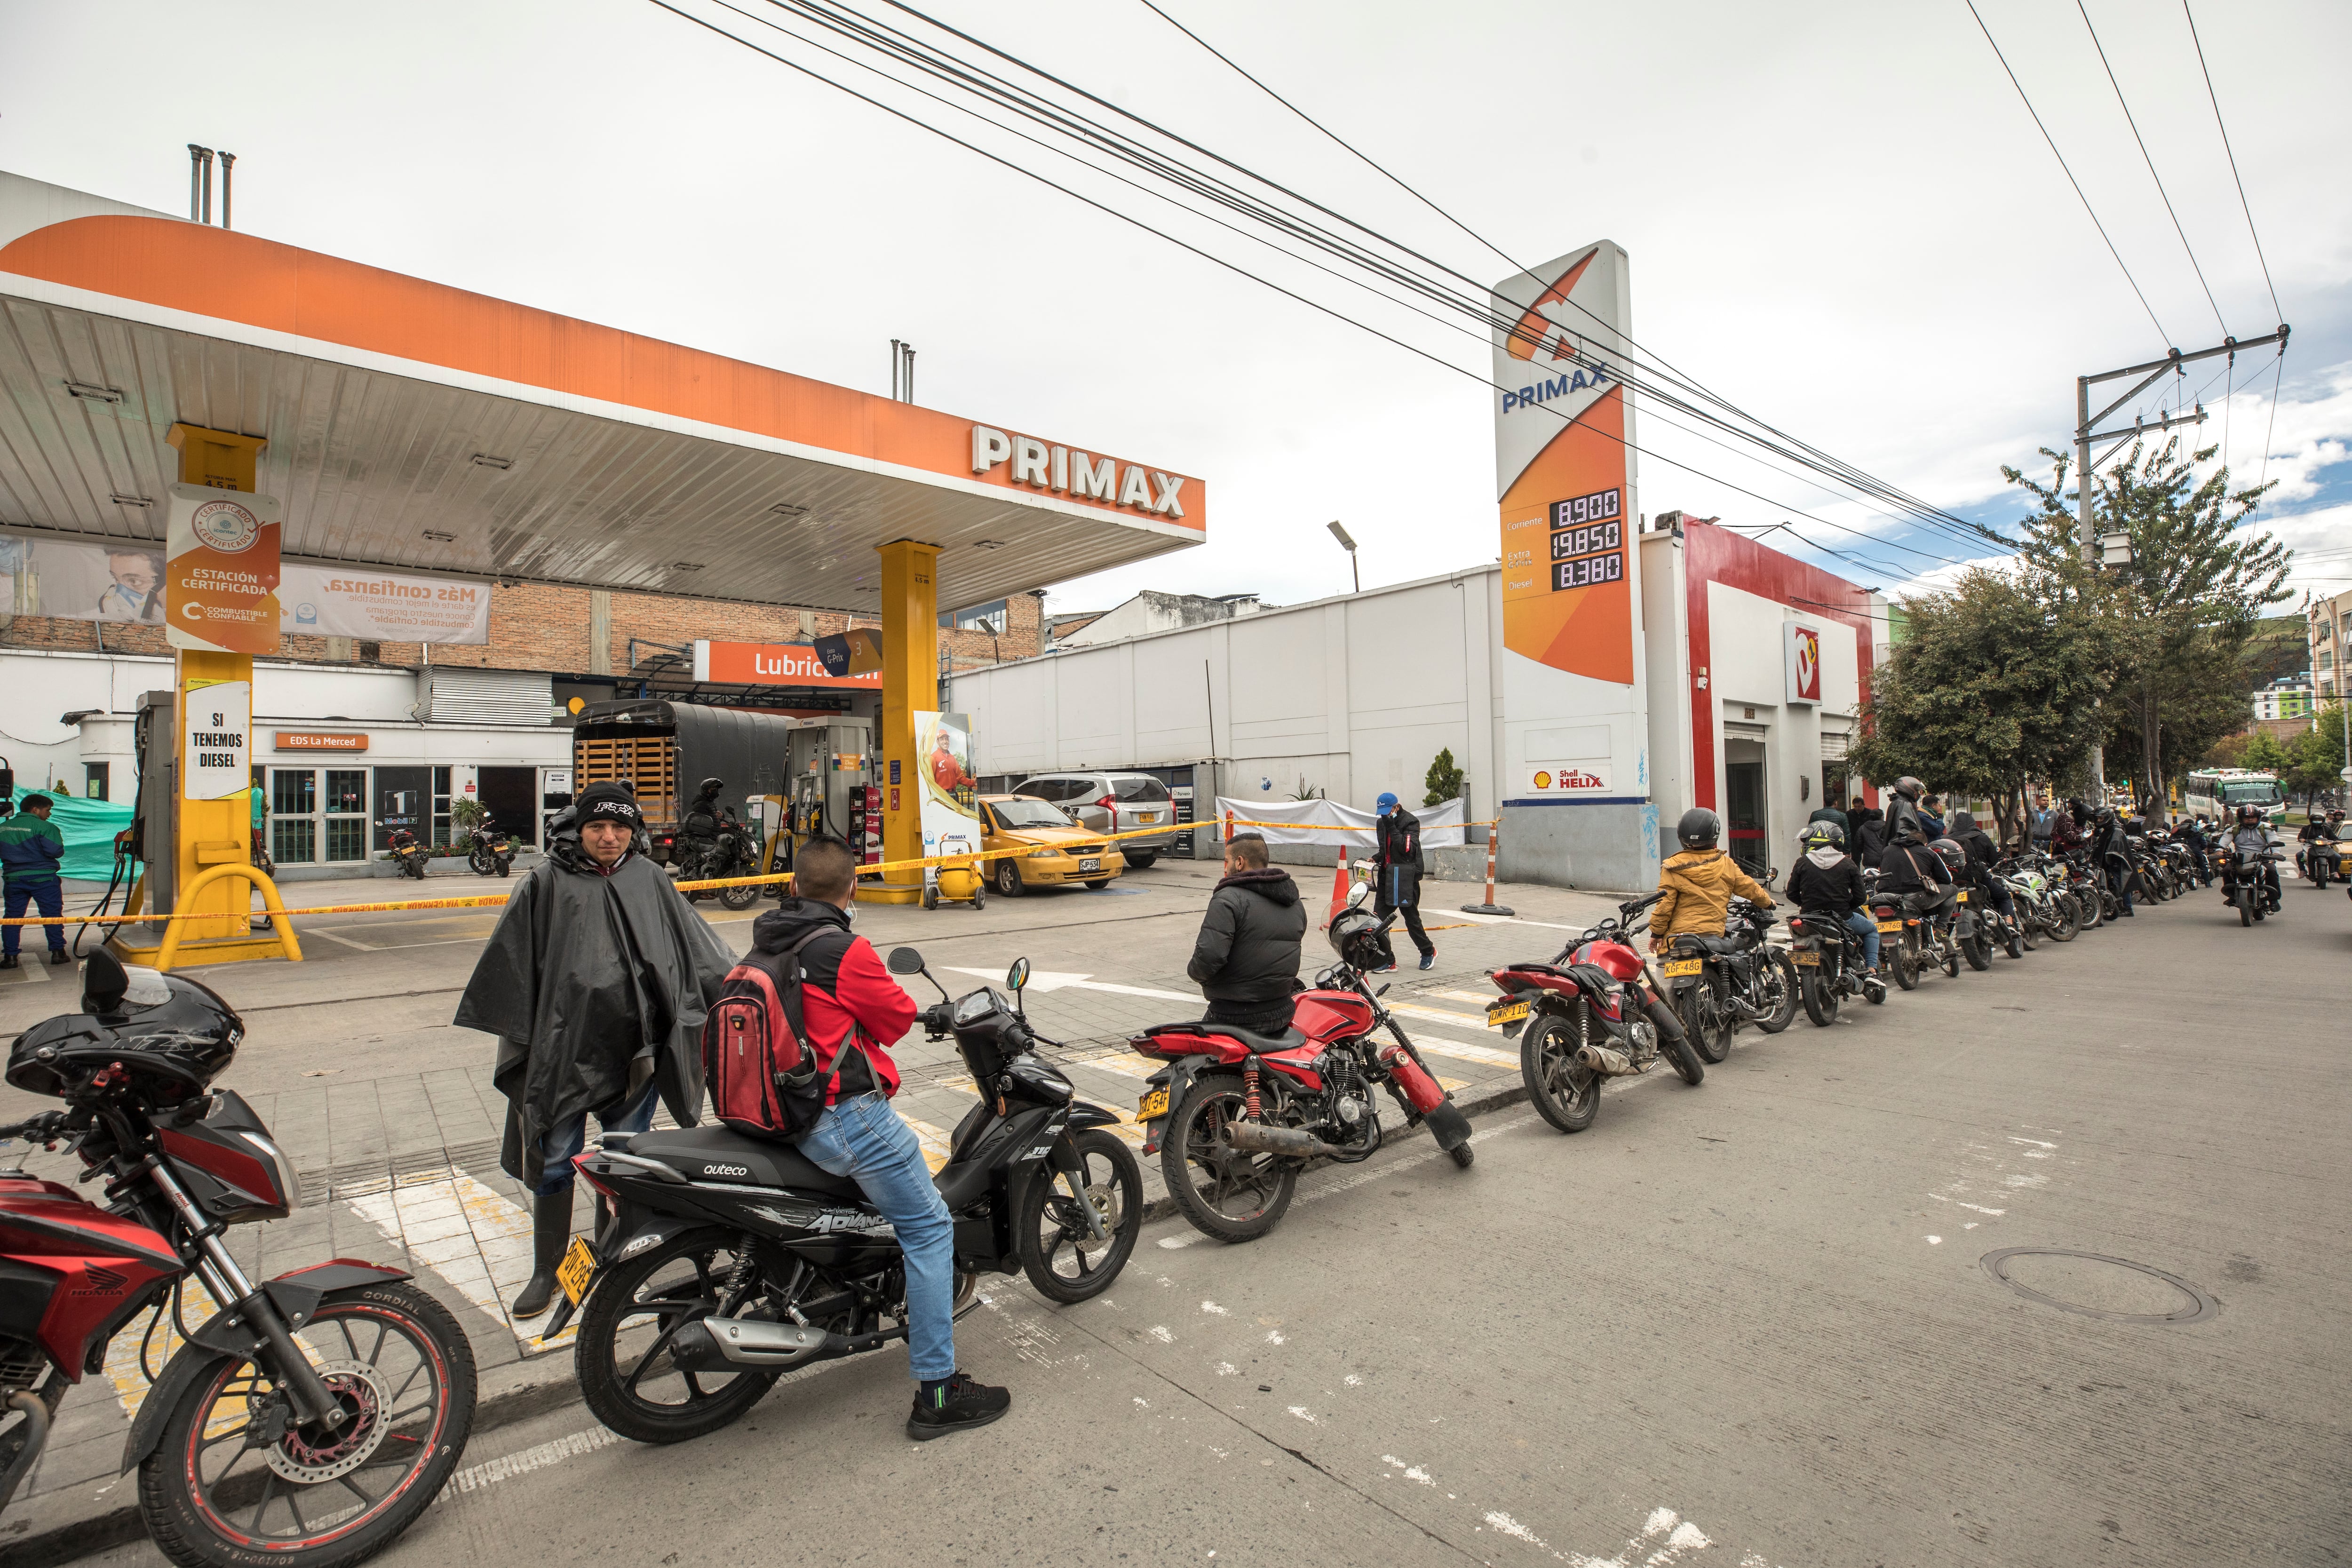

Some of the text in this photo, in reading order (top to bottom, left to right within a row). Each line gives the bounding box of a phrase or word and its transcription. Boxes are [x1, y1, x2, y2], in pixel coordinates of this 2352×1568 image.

[1503, 361, 1609, 414] PRIMAX
[972, 425, 1185, 518] PRIMAX
[200, 504, 251, 523] CERTIFICADO
[1559, 491, 1618, 526] 8.900
[1507, 517, 1543, 531] Corriente
[199, 528, 250, 548] CERTIFICADO
[1508, 550, 1530, 559] Extra
[1508, 558, 1532, 569] G-Prix
[1561, 554, 1620, 587] 8.380
[193, 568, 257, 584] ESTACIÓN
[182, 578, 268, 596] CERTIFICADA
[1509, 579, 1532, 590] Diesel
[207, 606, 268, 617] COMBUSTIBLE
[207, 613, 256, 621] CONFIABLE
[856, 641, 862, 656] 3
[827, 653, 843, 664] G-Prix
[212, 713, 223, 727] SI
[193, 732, 242, 748] TENEMOS
[290, 736, 308, 745] EDS
[324, 737, 355, 746] Merced
[200, 753, 235, 767] DIESEL
[1559, 775, 1605, 788] HELIX
[394, 792, 405, 813] 1
[946, 856, 971, 865] CERRADA
[704, 1164, 747, 1176] auteco
[363, 1291, 419, 1315] CORDIAL
